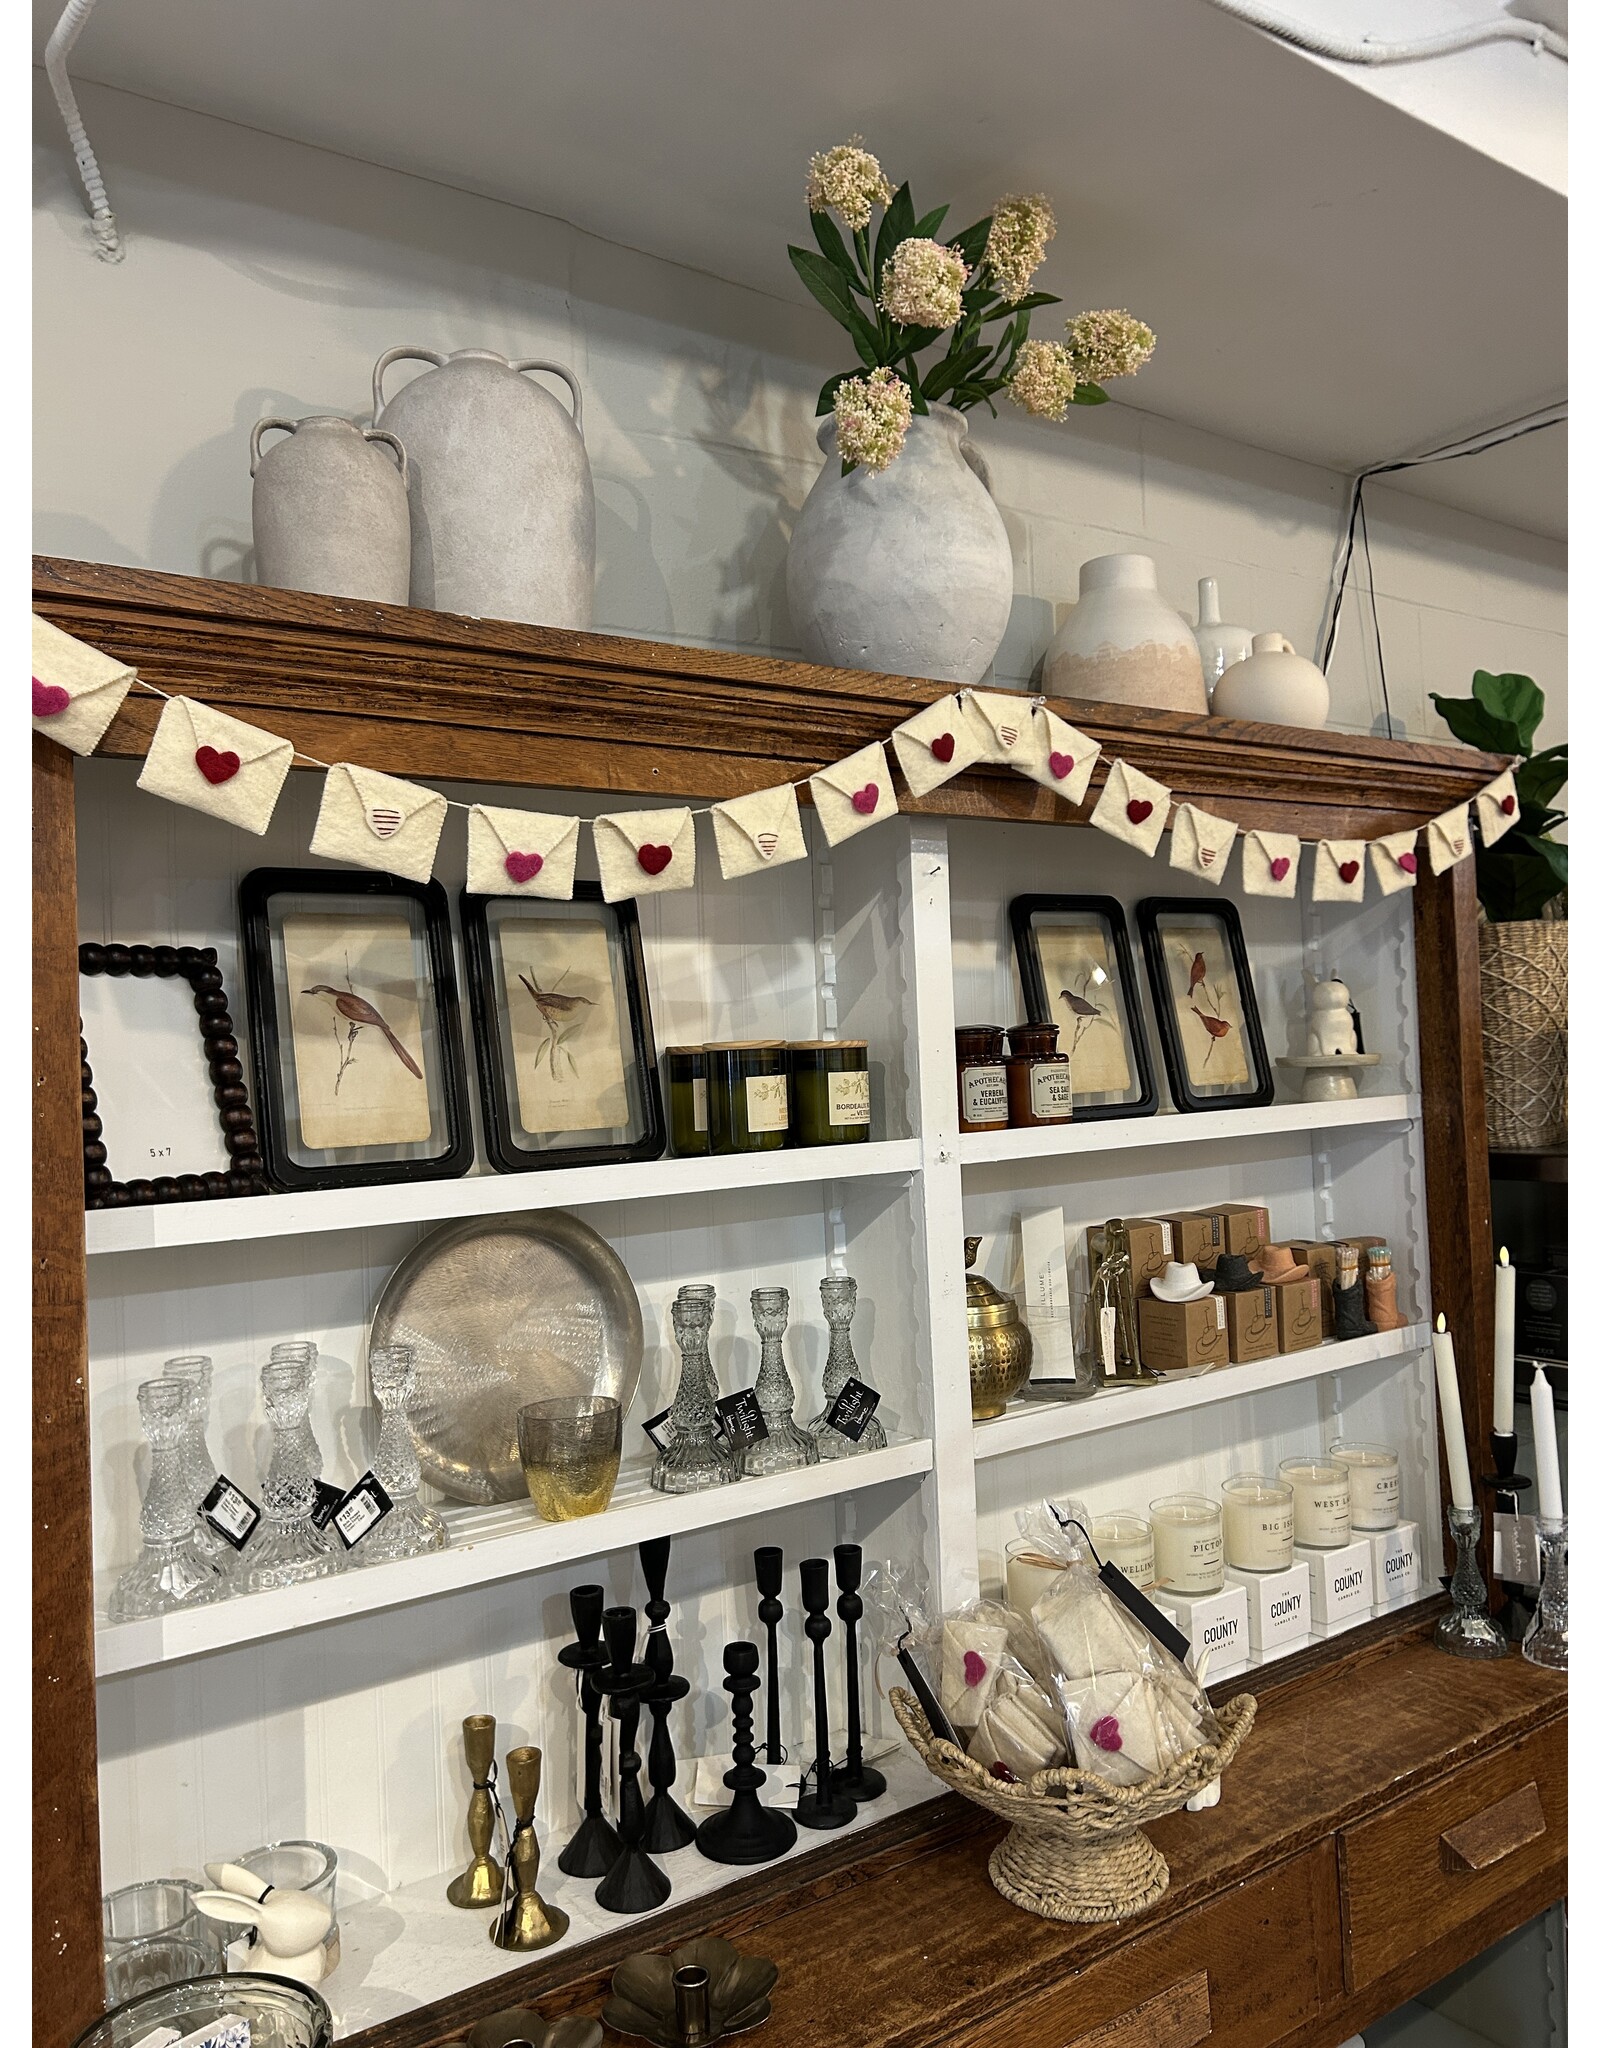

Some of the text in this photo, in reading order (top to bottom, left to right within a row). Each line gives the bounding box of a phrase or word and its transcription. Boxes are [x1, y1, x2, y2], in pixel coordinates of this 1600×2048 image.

[972, 1098, 978, 1106] &
[149, 1148, 156, 1158] 5
[165, 1147, 171, 1156] 7
[1038, 1274, 1046, 1306] ILLUME
[735, 1397, 758, 1440] Twilight
[834, 1390, 865, 1425] Twilight
[1314, 1499, 1341, 1508] WEST
[1262, 1522, 1280, 1531] BIG
[1385, 1552, 1413, 1574] COUNTY
[1334, 1569, 1363, 1593] COUNTY
[1270, 1593, 1302, 1619] COUNTY
[1203, 1618, 1239, 1645] COUNTY
[1211, 1642, 1227, 1652] ANDLE
